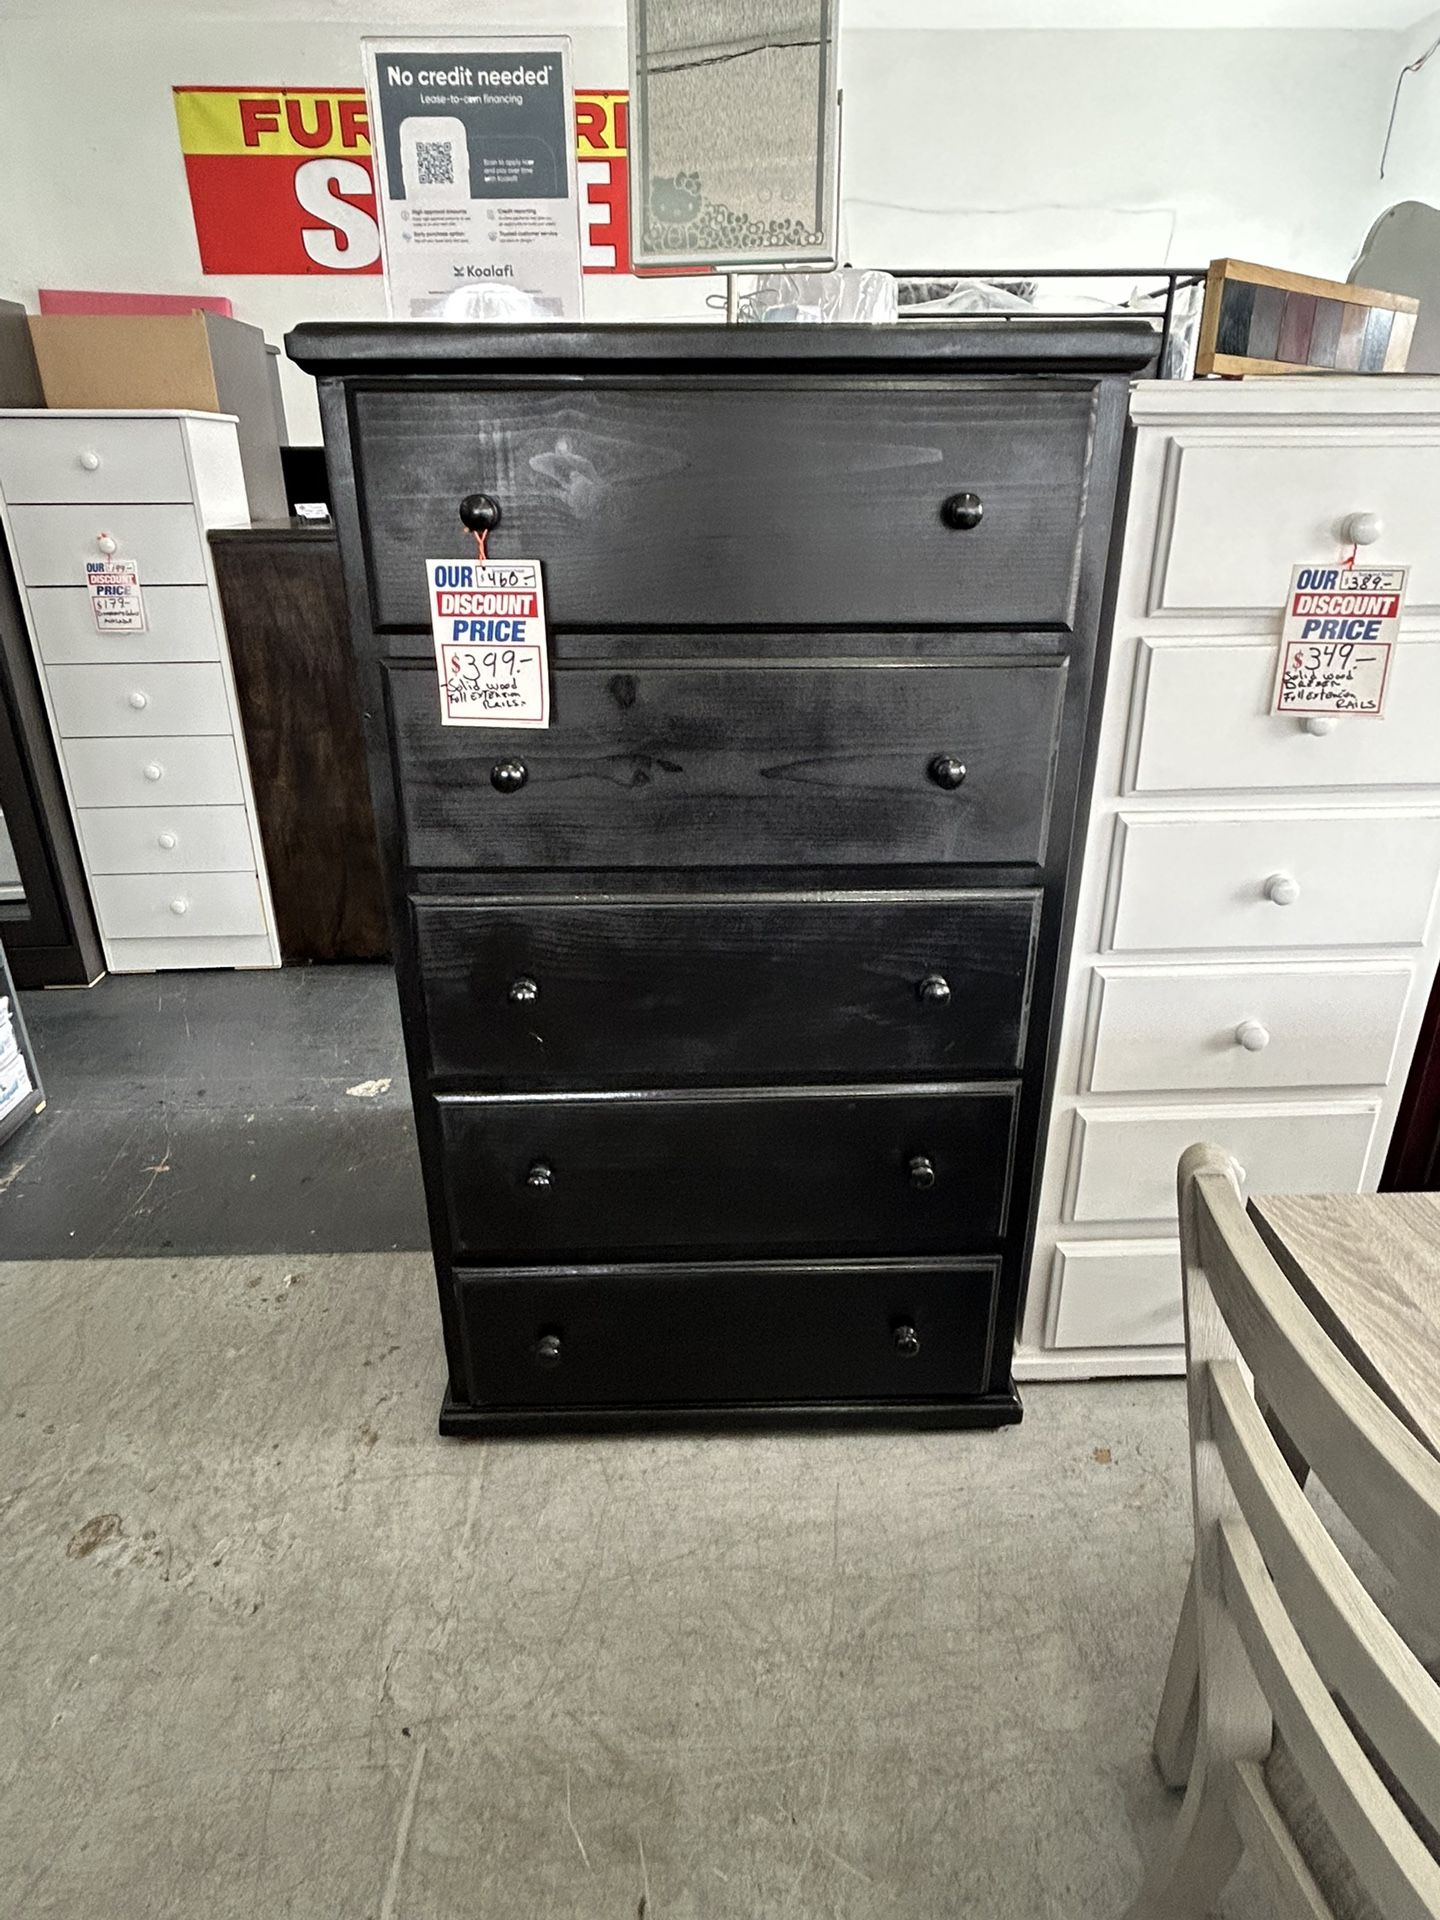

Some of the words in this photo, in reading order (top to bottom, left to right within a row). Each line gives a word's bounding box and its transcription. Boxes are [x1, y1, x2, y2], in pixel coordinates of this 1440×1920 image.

[387, 66, 413, 86] No
[418, 66, 473, 86] credit
[420, 93, 482, 104] Lease-to-own
[484, 93, 523, 105] financing
[467, 264, 514, 278] Koalafi
[86, 563, 104, 572] OUR
[435, 566, 473, 588] OUR
[90, 575, 134, 584] DISCOUNT
[1297, 569, 1339, 590] OUR
[97, 586, 131, 596] PRICE
[441, 593, 534, 615] DISCOUNT
[1296, 596, 1396, 616] DISCOUNT
[453, 620, 527, 642] PRICE
[1301, 619, 1382, 640] PRICE
[486, 678, 518, 690] wood
